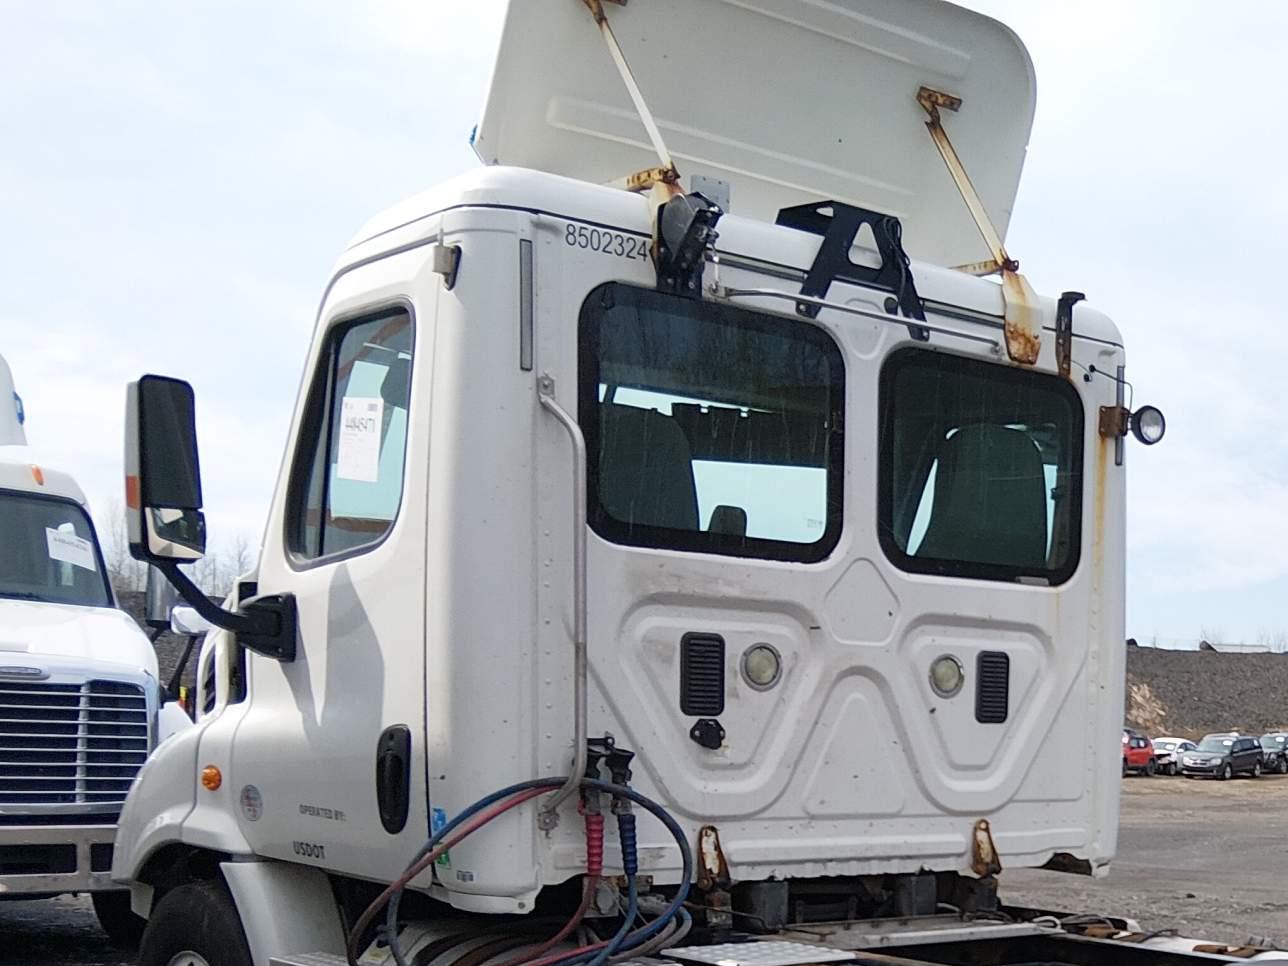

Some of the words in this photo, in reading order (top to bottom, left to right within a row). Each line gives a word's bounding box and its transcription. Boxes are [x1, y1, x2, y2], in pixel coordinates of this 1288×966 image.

[565, 223, 648, 262] 8502324
[299, 804, 333, 819] OPERATED
[293, 840, 326, 860] USDOT
